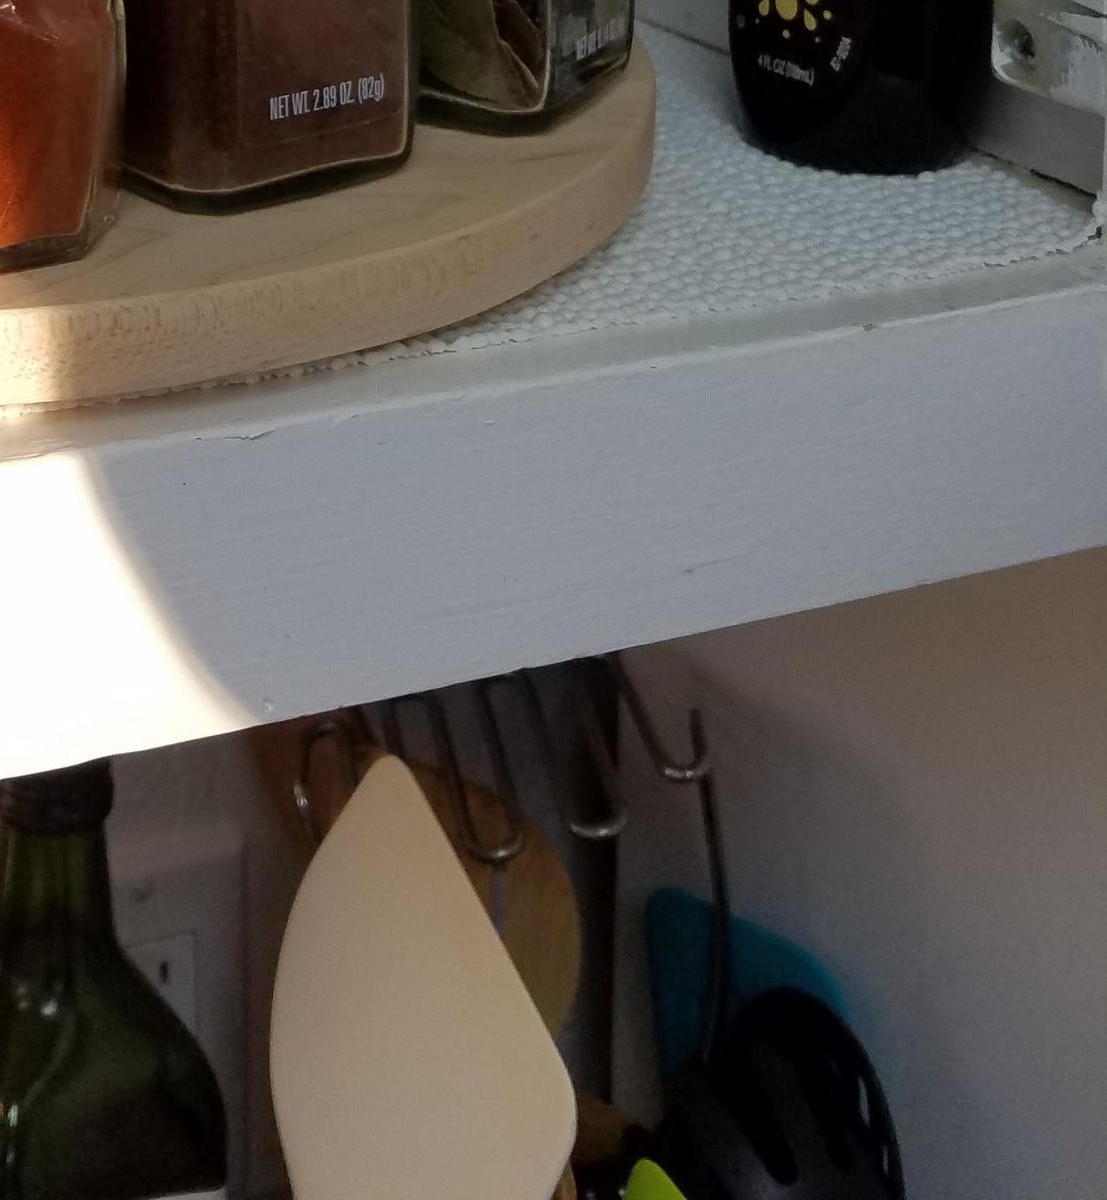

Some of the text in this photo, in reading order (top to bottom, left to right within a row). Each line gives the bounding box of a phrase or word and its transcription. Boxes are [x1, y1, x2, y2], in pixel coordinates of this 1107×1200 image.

[270, 94, 290, 120] NET
[313, 85, 337, 111] 2.89
[357, 73, 385, 104] (82g)
